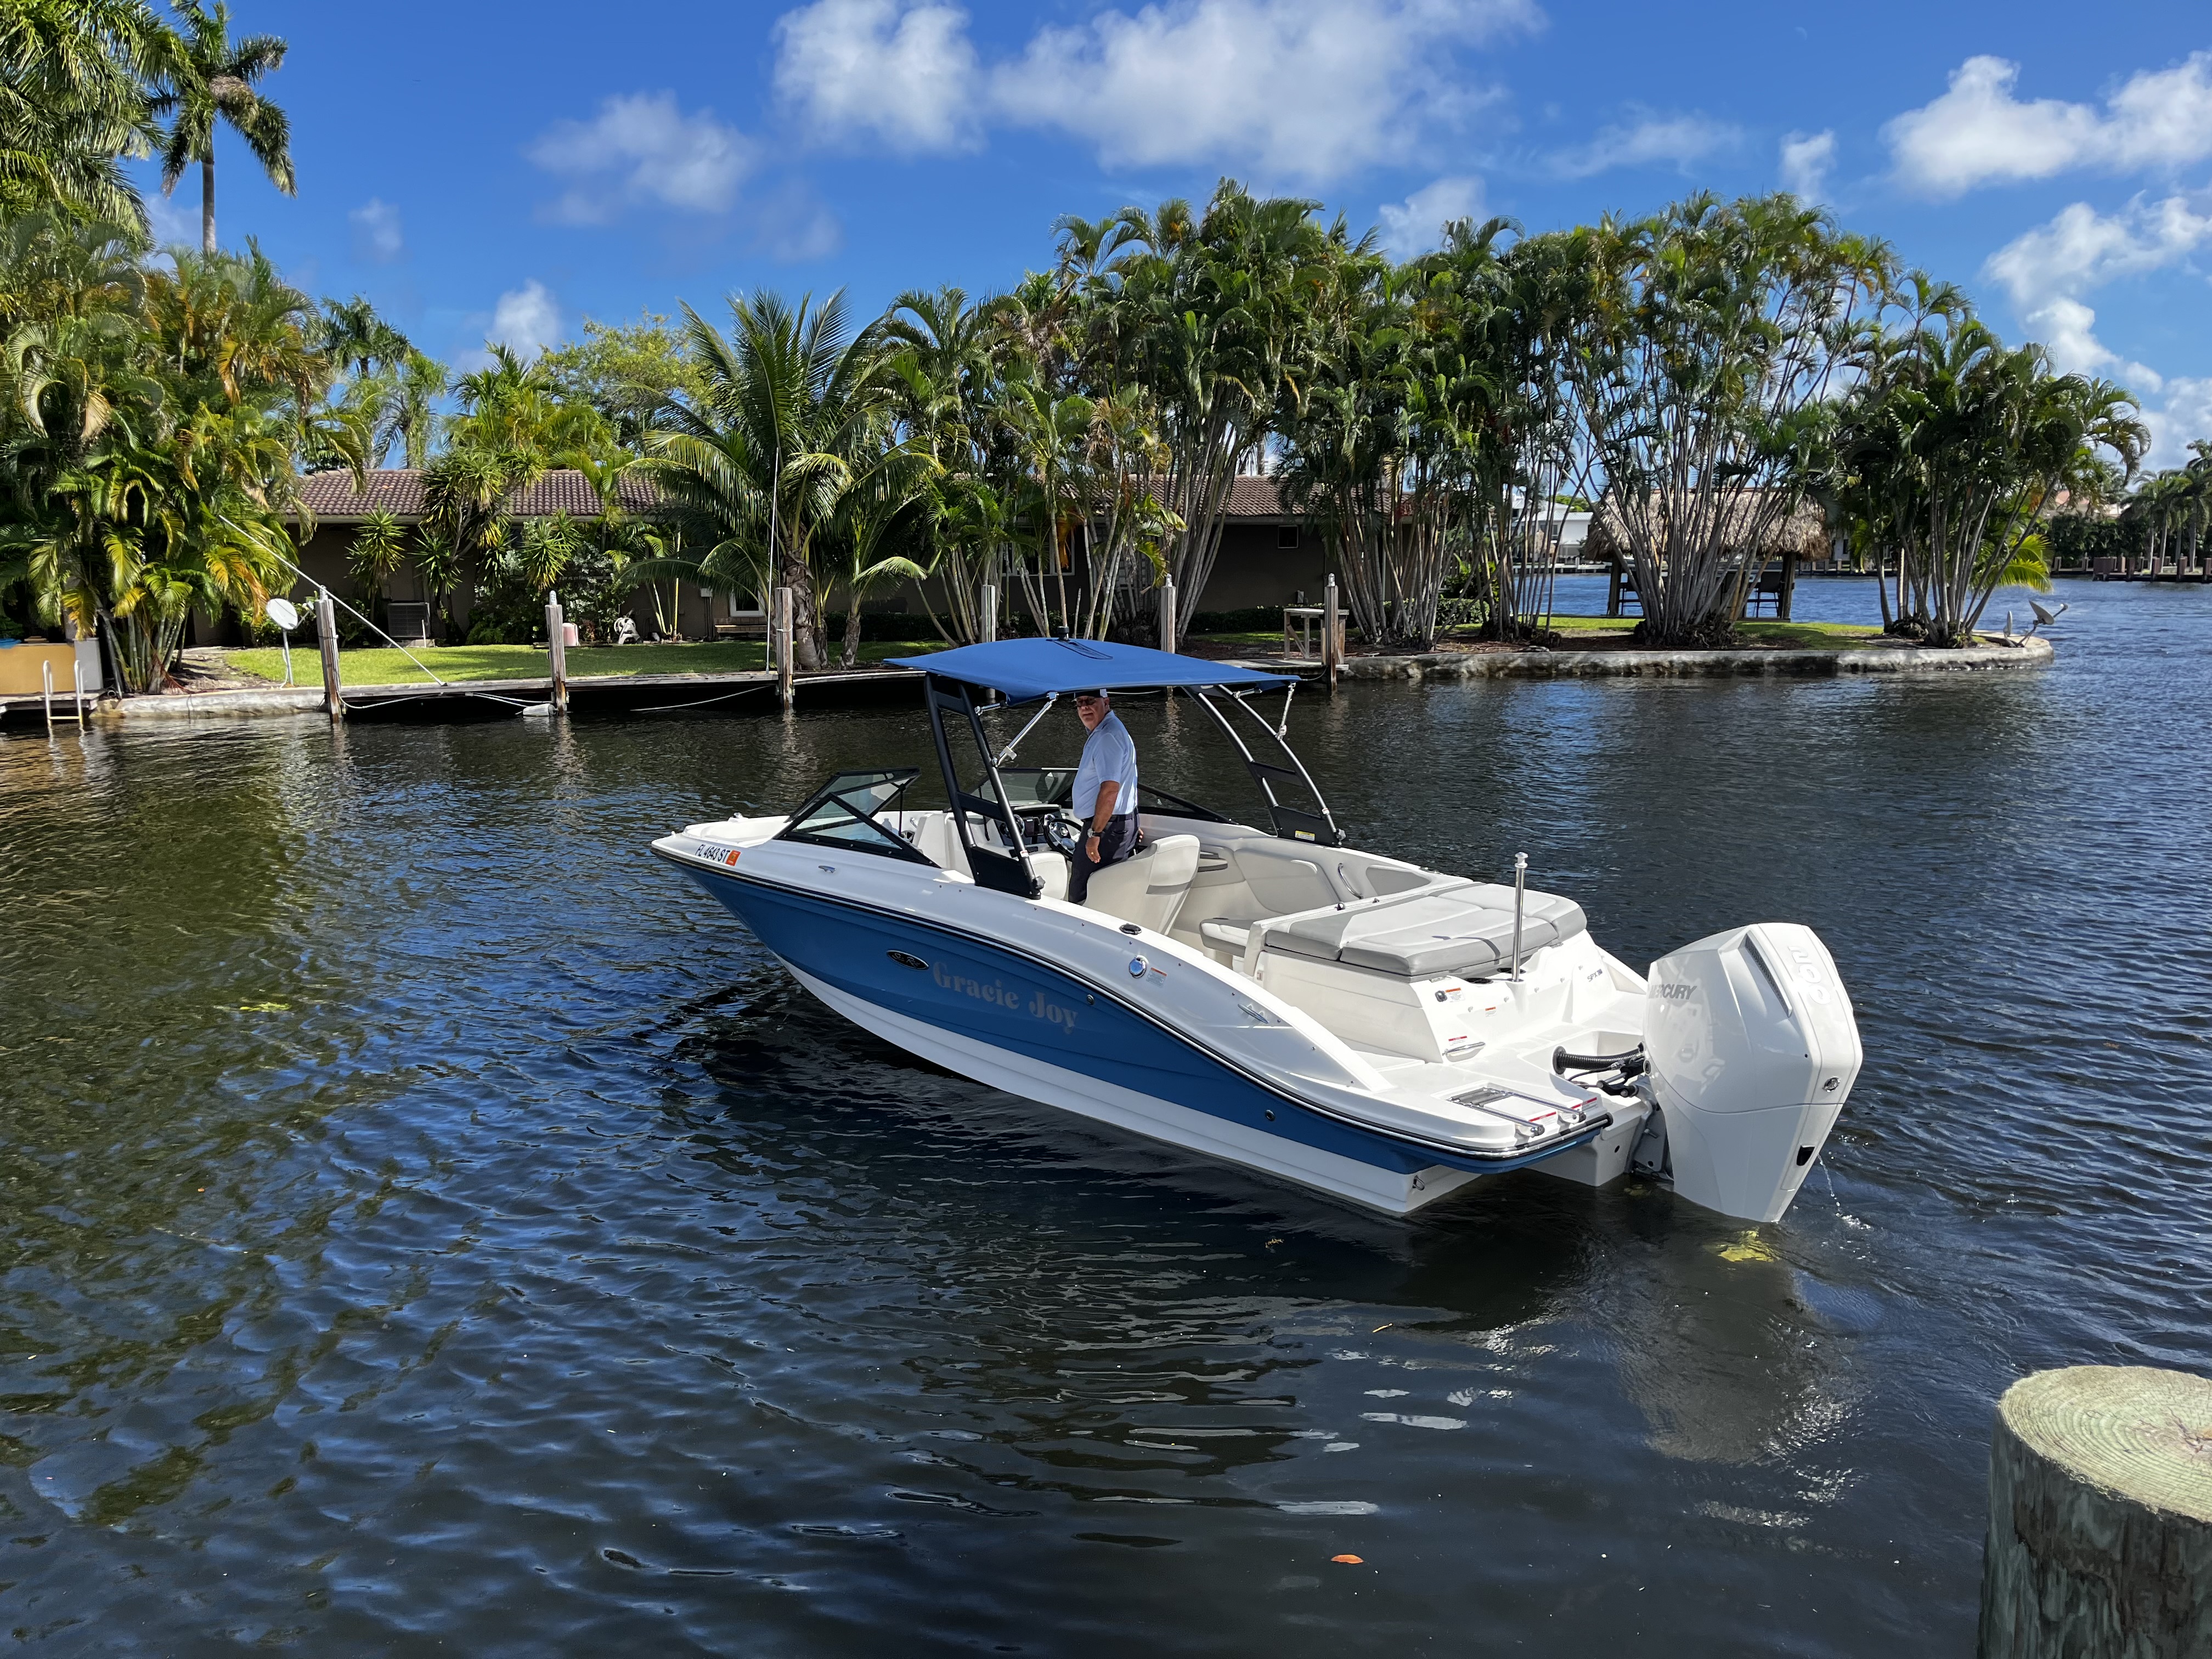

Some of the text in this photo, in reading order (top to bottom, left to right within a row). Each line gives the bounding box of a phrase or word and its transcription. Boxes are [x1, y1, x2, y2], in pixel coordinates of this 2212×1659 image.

[695, 844, 731, 862] FL 4643 ST
[933, 962, 1078, 1035] Gracie Joy
